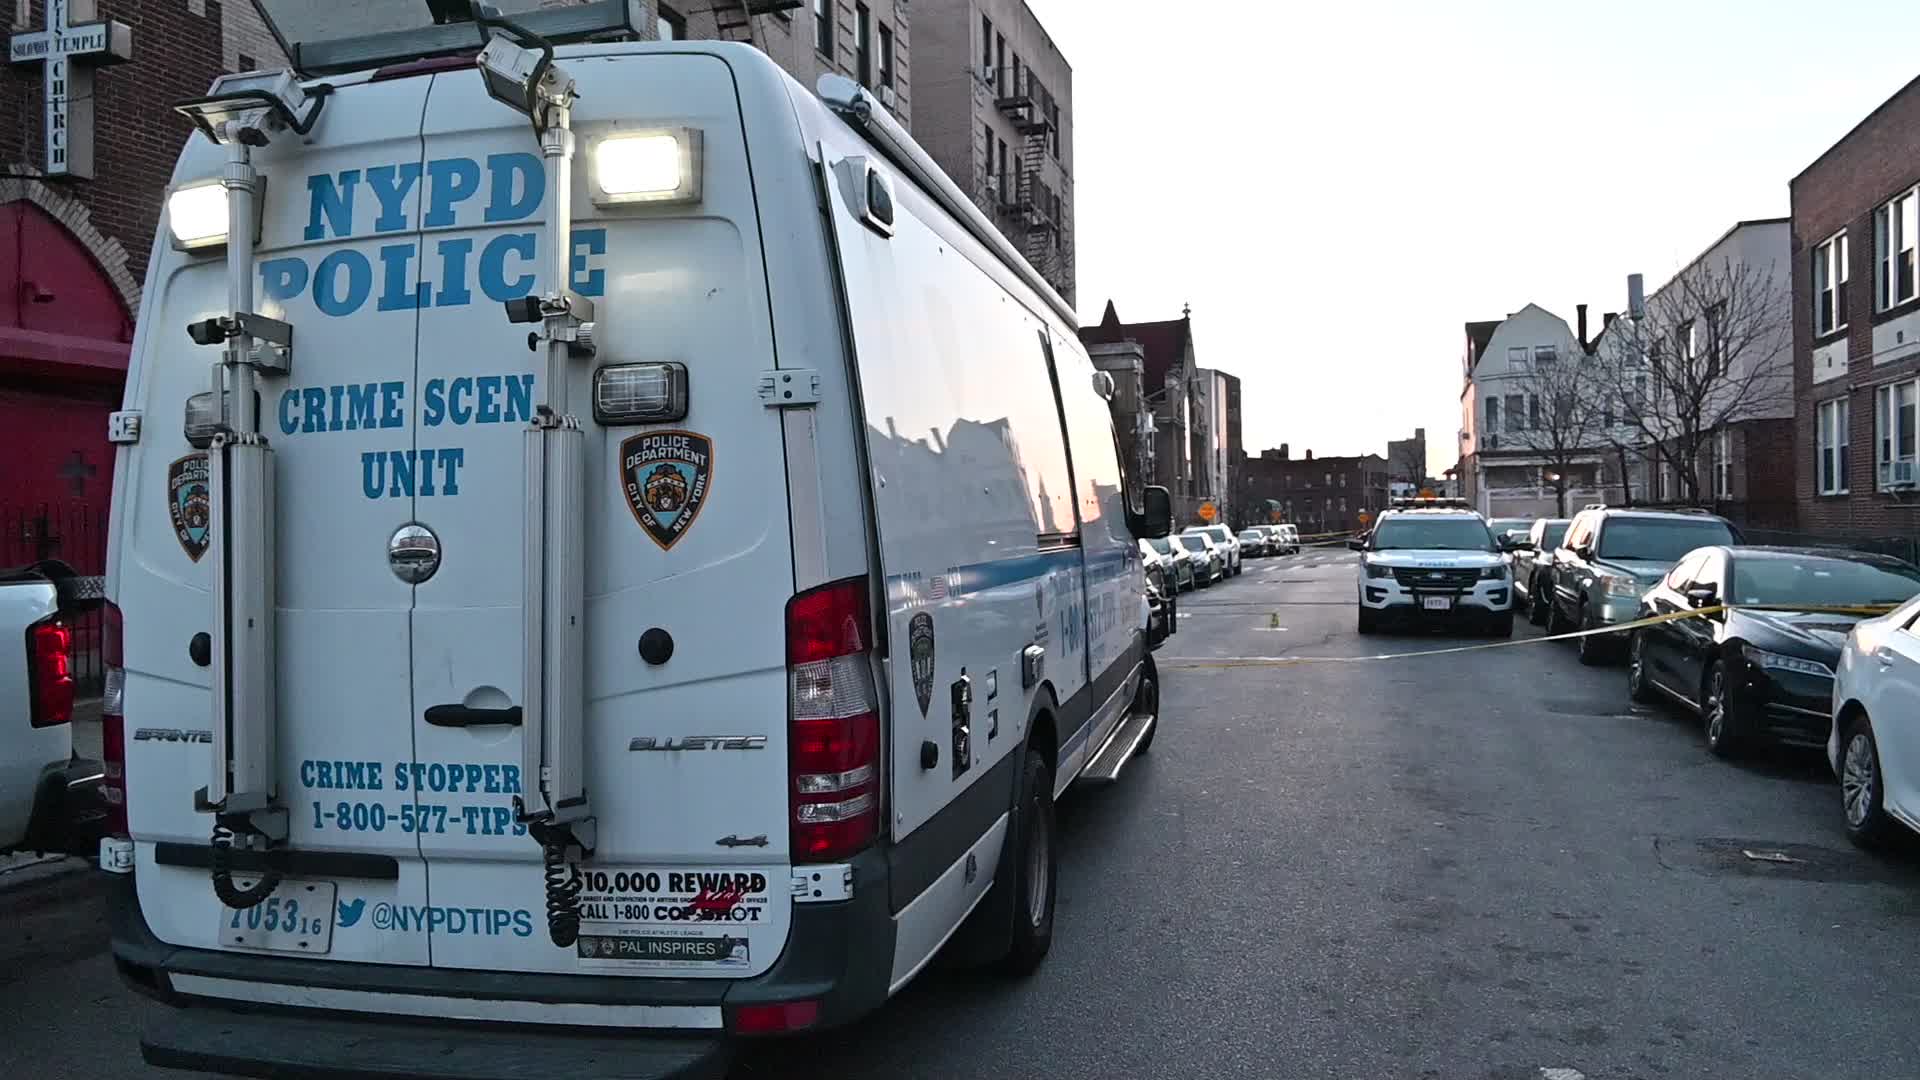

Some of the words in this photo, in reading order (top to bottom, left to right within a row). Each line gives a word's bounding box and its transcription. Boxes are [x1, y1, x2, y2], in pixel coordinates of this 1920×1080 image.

[55, 34, 104, 52] TEMPLE
[53, 61, 65, 163] CHURCH
[304, 152, 546, 241] NYPD
[259, 228, 606, 317] POLICE
[278, 381, 404, 436] CRIME
[423, 374, 535, 427] SCEN
[643, 436, 690, 449] POLICE
[183, 460, 209, 472] POLIC
[626, 447, 707, 470] DEPARTMENT
[171, 469, 209, 490] DEPARTM
[361, 448, 464, 500] UNIT
[627, 482, 645, 509] CITY
[642, 512, 656, 527] OF
[673, 508, 692, 532] NEW
[690, 473, 707, 503] YORK
[134, 728, 214, 743] SPRINTE
[629, 736, 767, 751] BLUETEC
[300, 760, 383, 790] CRIME
[395, 763, 521, 794] STOPPER
[313, 802, 528, 836] 1-800-577-TIPS
[668, 872, 767, 894] REWARD
[371, 902, 533, 937] @NYPDTIPS
[580, 903, 609, 919] CALL
[613, 904, 649, 920] 1-800
[300, 917, 322, 935] 16
[618, 940, 646, 953] PAL
[648, 941, 716, 955] INSPIRES
